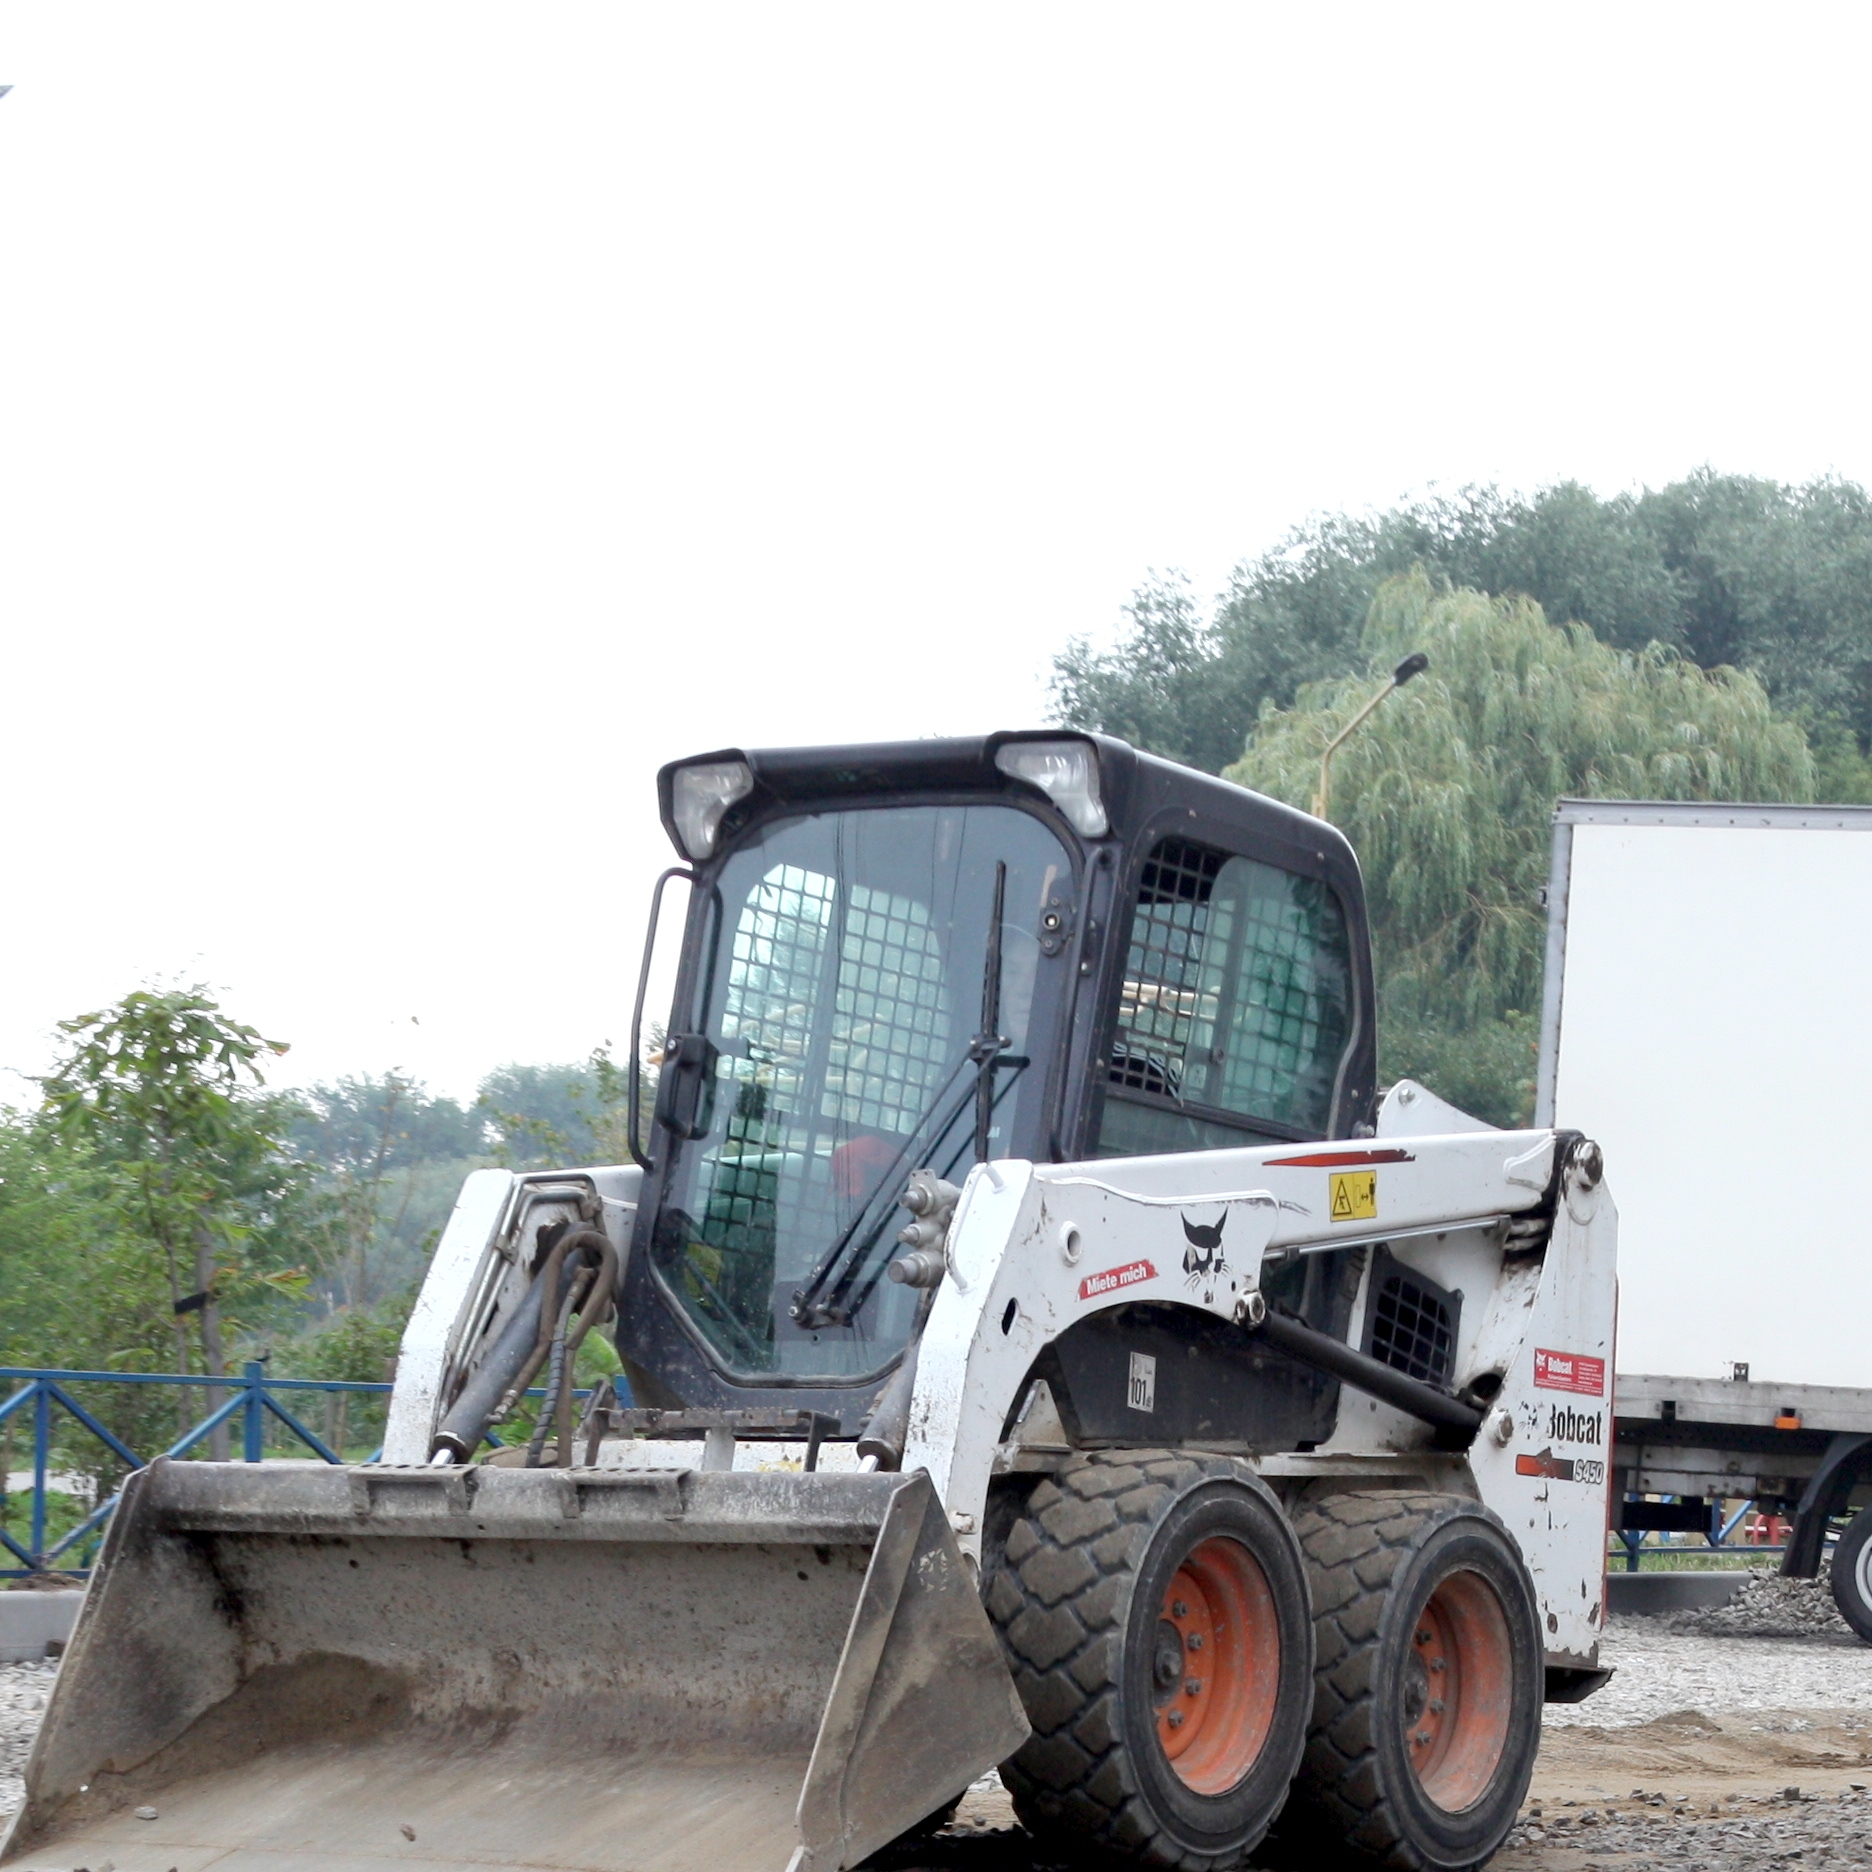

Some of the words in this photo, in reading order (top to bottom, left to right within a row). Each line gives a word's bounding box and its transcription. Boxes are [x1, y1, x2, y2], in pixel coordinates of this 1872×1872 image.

[1086, 1275, 1117, 1295] Miete
[1120, 1263, 1147, 1285] mich
[1548, 1356, 1573, 1375] Bobcat
[1131, 1377, 1146, 1406] 101
[1575, 1459, 1604, 1485] S450
